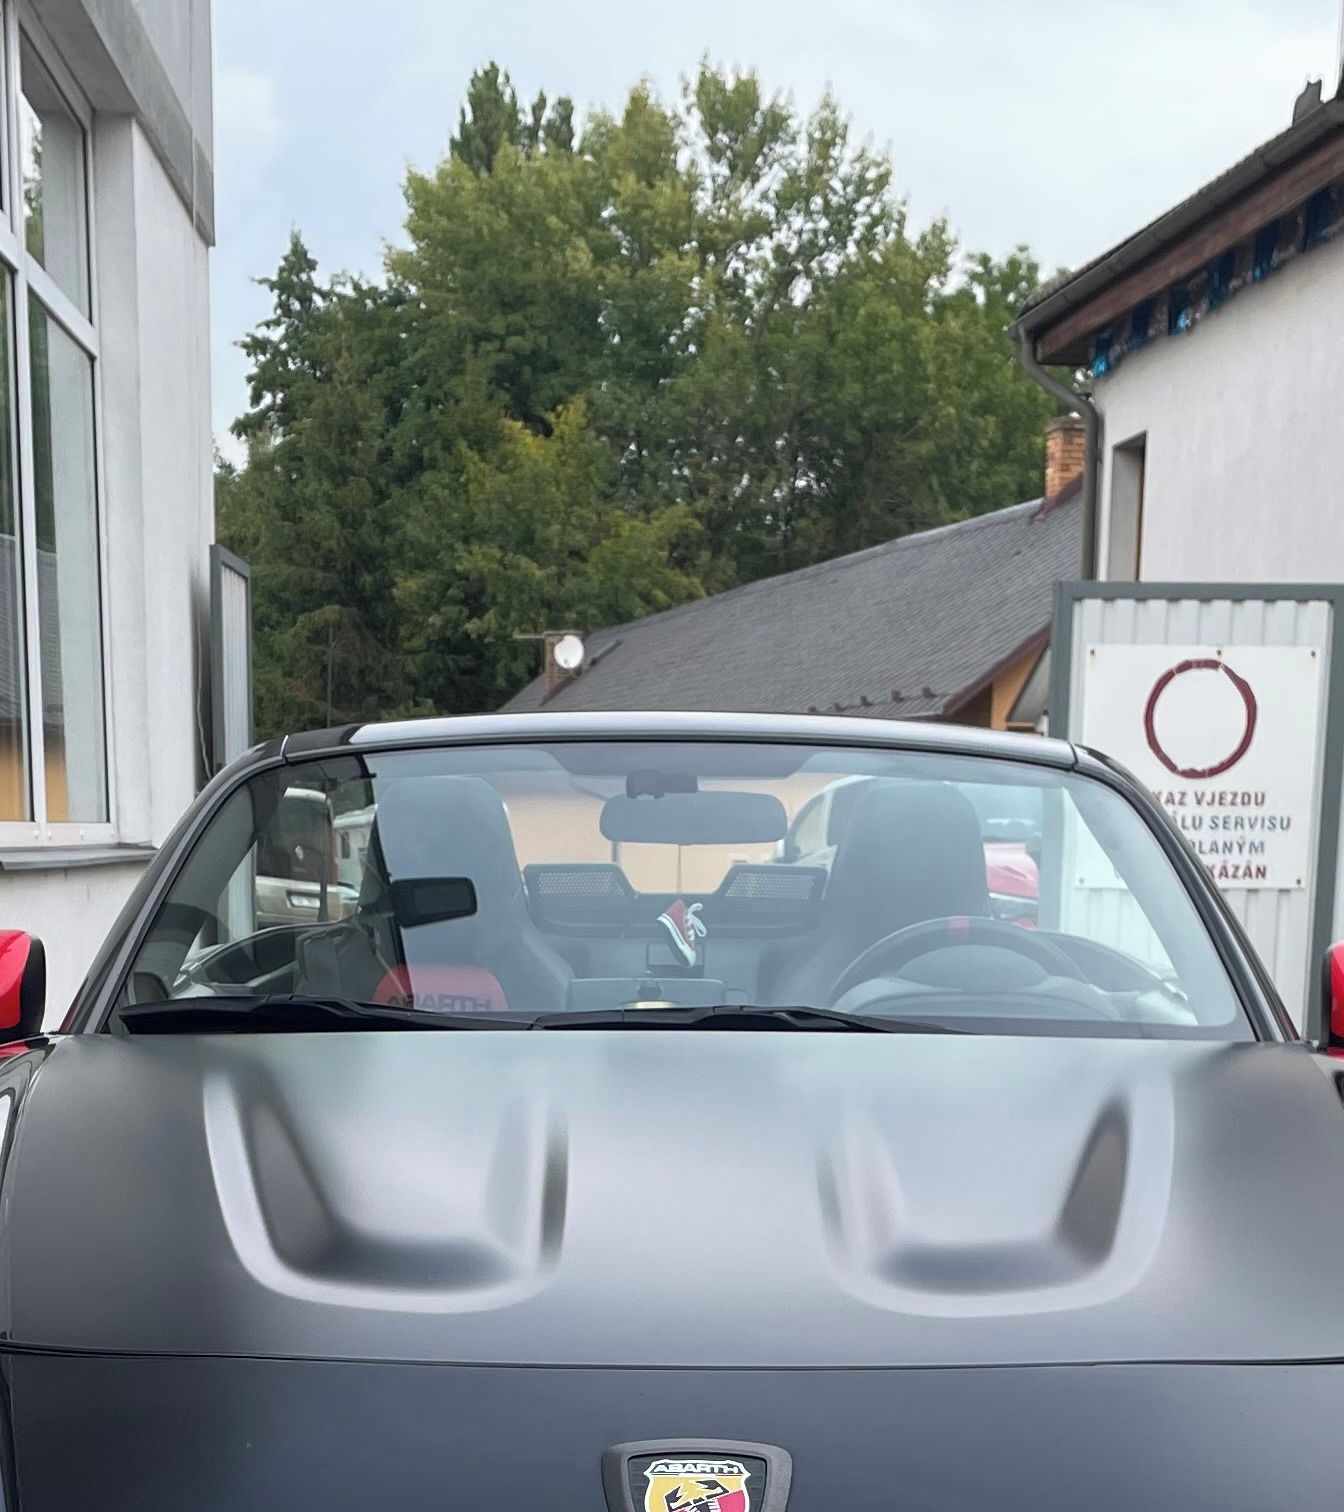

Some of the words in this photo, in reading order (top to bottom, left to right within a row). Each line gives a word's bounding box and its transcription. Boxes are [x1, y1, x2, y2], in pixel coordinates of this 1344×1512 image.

[1194, 791, 1266, 807] VJEZDU
[1209, 814, 1292, 832] SERVISU
[653, 1463, 739, 1474] ABARTH
